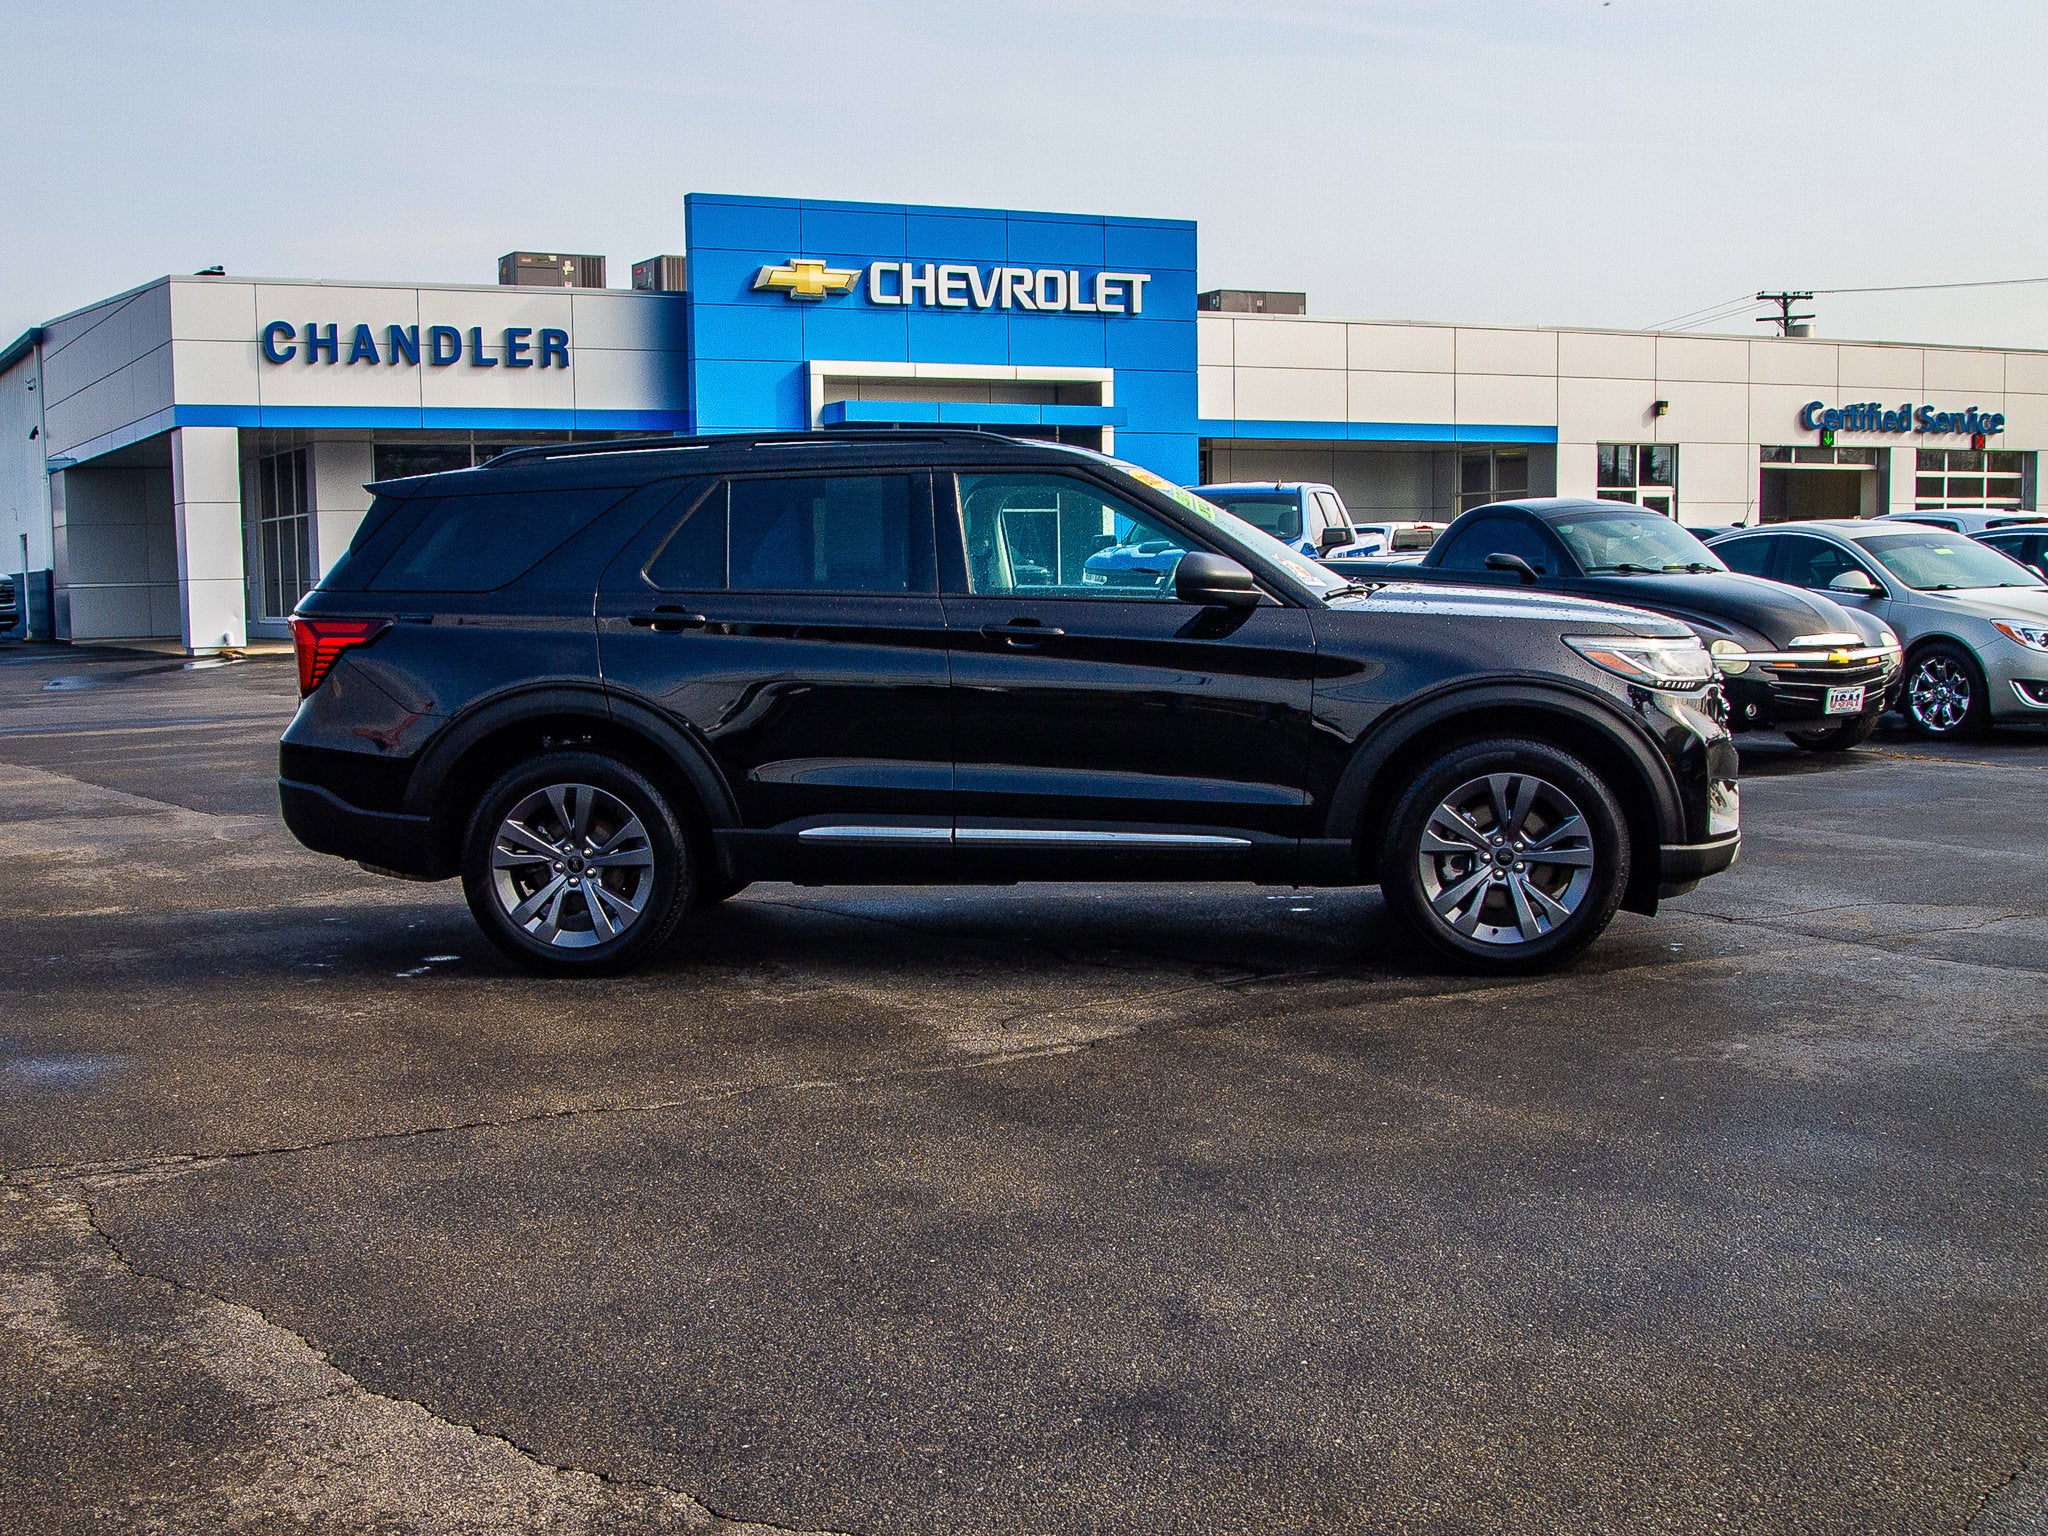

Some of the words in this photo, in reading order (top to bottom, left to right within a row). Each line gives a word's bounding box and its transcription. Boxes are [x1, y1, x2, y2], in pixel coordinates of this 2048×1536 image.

[870, 262, 1151, 314] CHEVROLET
[262, 320, 571, 368] CHANDLER
[1804, 401, 1912, 432] Certified
[1918, 405, 2005, 434] Service
